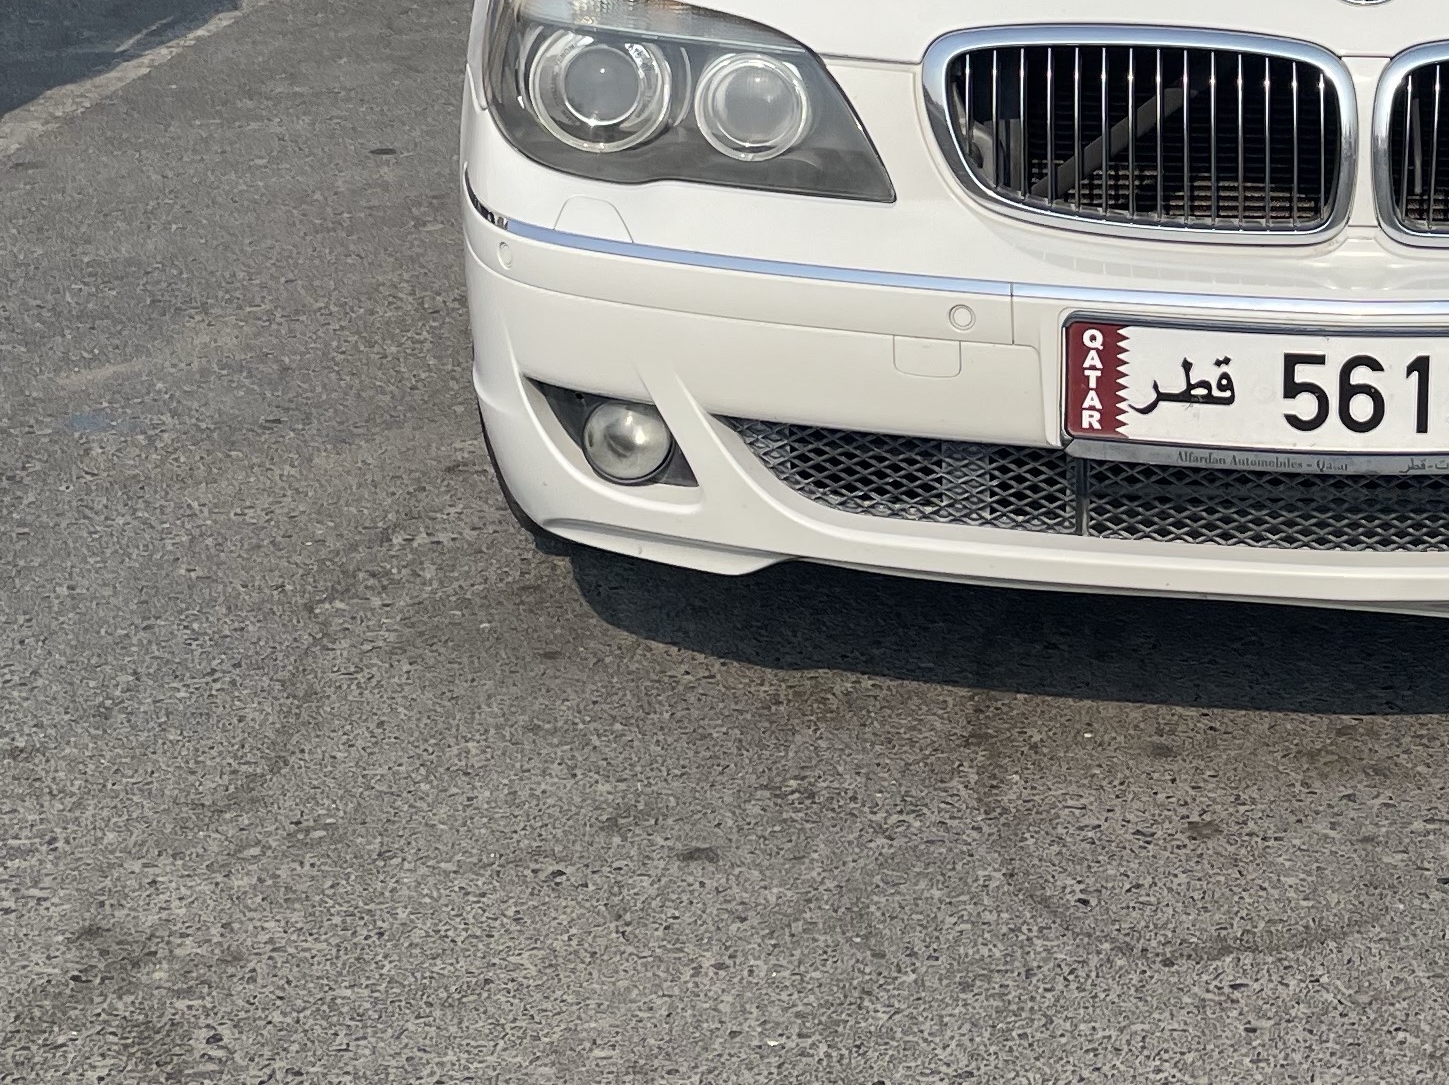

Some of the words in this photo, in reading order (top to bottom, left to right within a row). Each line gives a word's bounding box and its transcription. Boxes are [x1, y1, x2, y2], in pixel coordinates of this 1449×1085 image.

[1081, 328, 1104, 430] QATAR
[1128, 355, 1236, 415] قطر
[1177, 451, 1226, 465] Alfardan
[1230, 454, 1303, 470] Automobiles
[1316, 459, 1348, 473] Qaa
